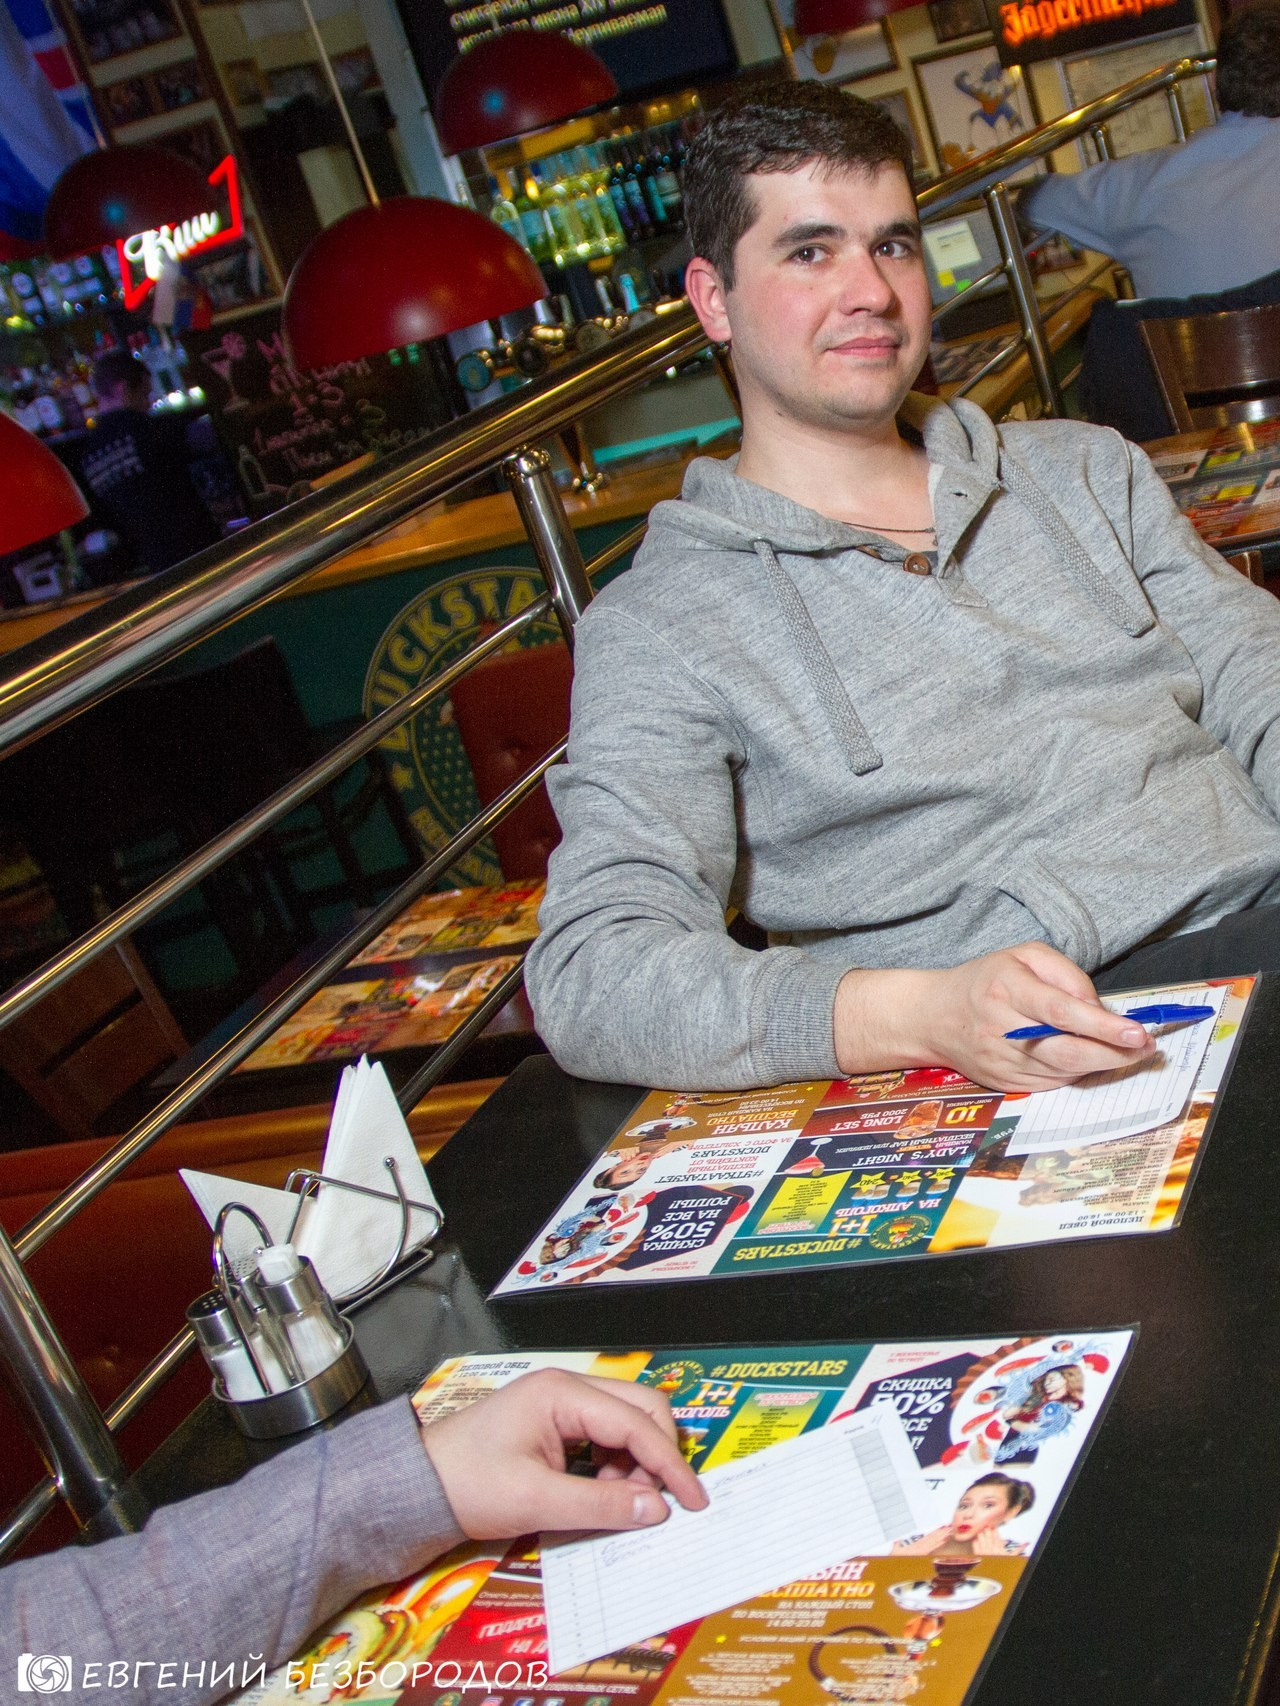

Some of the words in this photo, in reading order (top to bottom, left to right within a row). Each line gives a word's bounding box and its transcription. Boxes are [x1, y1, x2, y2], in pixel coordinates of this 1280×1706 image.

[706, 1109, 799, 1126] БЕСПЛАТНО
[945, 1104, 984, 1125] 10
[711, 1119, 793, 1135] КАЛЬЯН
[830, 1120, 862, 1132] SET
[862, 1115, 904, 1129] LONG
[852, 1153, 904, 1167] NIGHT
[910, 1146, 969, 1160] LADY'S
[859, 1179, 880, 1187] 240
[835, 1200, 914, 1218] АЛКОГОЛЬ
[918, 1198, 942, 1210] НА
[661, 1210, 696, 1222] ВСЕ
[696, 1208, 722, 1220] НА
[826, 1213, 878, 1239] 1+1
[1059, 1221, 1089, 1230] ОБЕД
[1090, 1216, 1144, 1229] ДЕЛОВОЙ
[645, 1220, 716, 1241] 50%
[642, 1237, 706, 1252] СКИДКА
[733, 1238, 862, 1261] #DUCKSTARS
[710, 1359, 848, 1379] #DUCKSTARS
[877, 1377, 952, 1392] СКИДКА
[687, 1381, 744, 1407] 1+1
[670, 1405, 731, 1419] КОГОЛЬ
